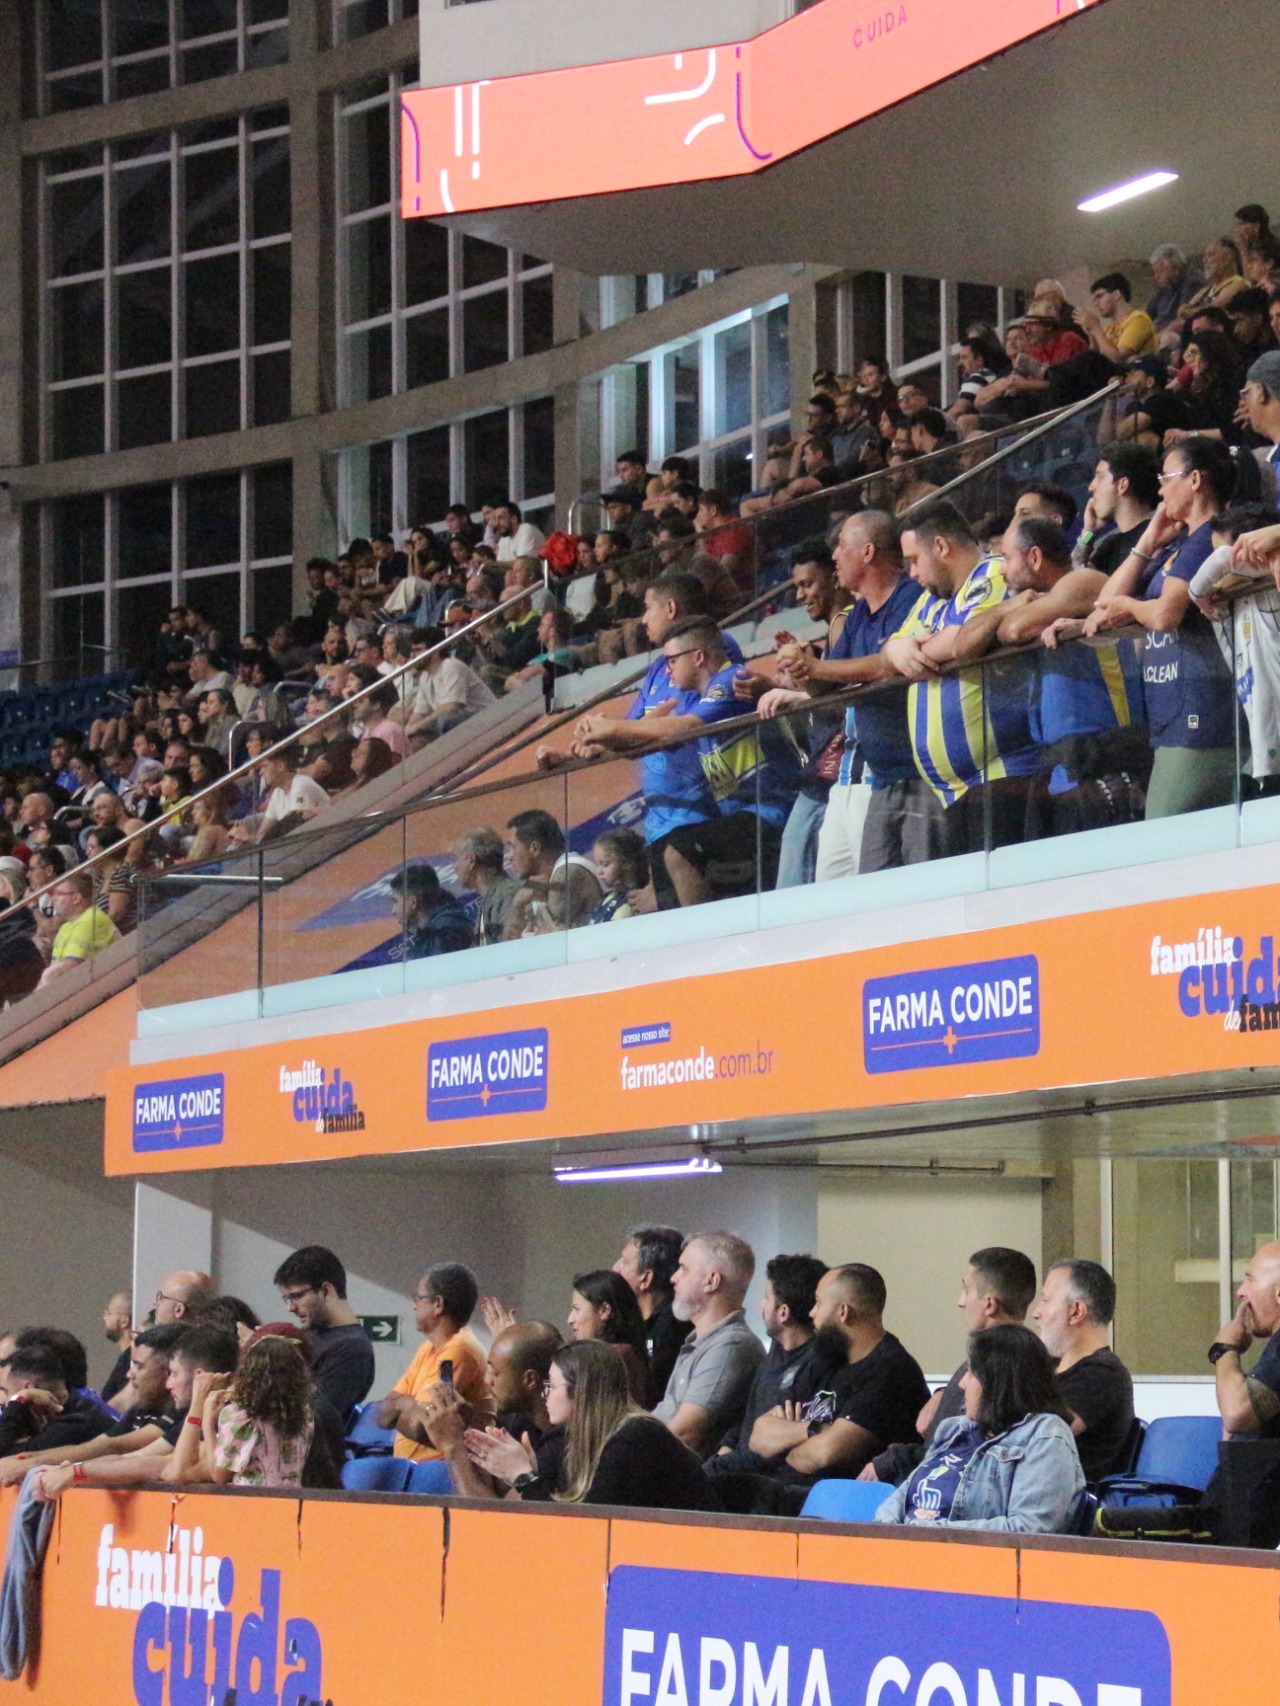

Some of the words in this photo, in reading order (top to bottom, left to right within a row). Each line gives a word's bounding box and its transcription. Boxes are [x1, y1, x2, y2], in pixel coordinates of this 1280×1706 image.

[1150, 926, 1236, 975] família
[868, 988, 945, 1035] FARMA
[950, 976, 1033, 1024] CONDE
[1223, 1002, 1241, 1032] de
[622, 1033, 640, 1045] acesse
[641, 1030, 657, 1040] nosso
[430, 1053, 483, 1089] FARMA
[487, 1045, 544, 1082] CONDE
[621, 1040, 774, 1091] farmaconde.com.br
[135, 1094, 176, 1125] FARMA
[179, 1087, 221, 1120] CONDE
[293, 1068, 354, 1122] cuida
[95, 1523, 228, 1621] família
[132, 1556, 323, 1706] cuida
